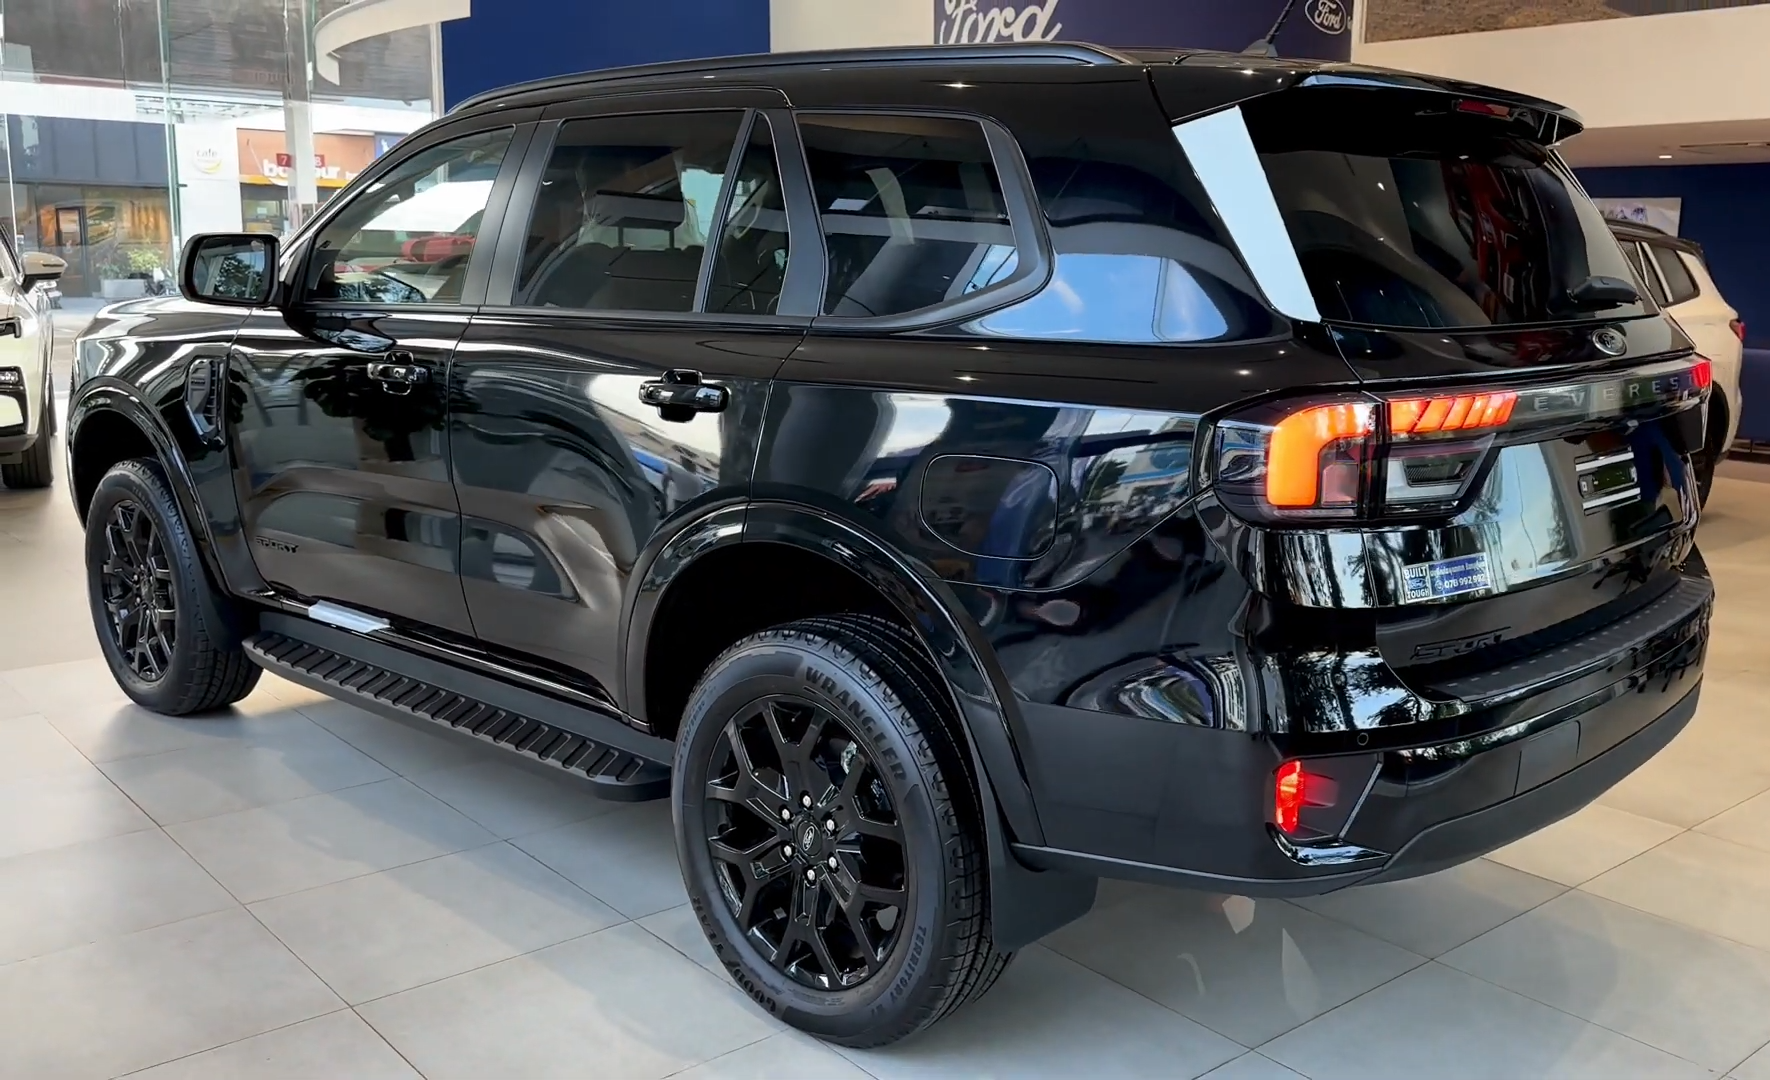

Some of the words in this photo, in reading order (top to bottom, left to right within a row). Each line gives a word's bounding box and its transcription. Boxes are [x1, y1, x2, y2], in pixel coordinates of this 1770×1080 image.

[1314, 0, 1342, 29] Ford
[1404, 566, 1427, 579] BUILT
[1406, 588, 1430, 600] TOUGH
[805, 666, 907, 781] WRANGLER
[890, 925, 927, 1005] TERRITORY
